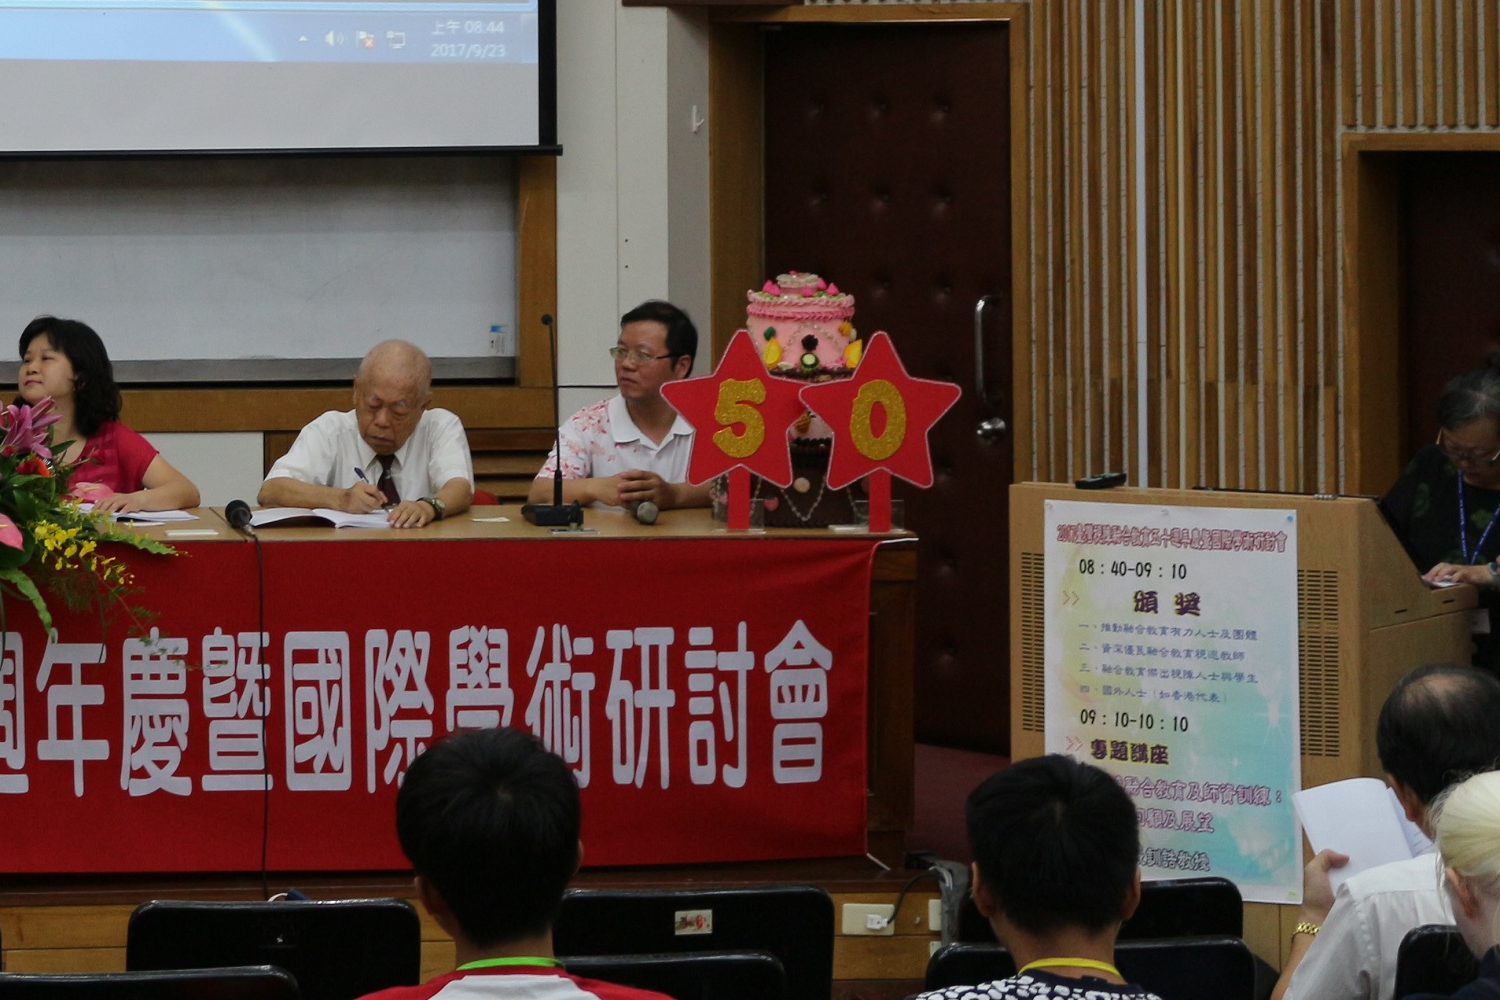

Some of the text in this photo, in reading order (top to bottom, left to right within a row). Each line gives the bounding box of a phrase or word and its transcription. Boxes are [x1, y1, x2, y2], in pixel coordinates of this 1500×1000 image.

[431, 20, 505, 35] 上午 08:44
[431, 43, 505, 58] 2017/9/23
[713, 378, 907, 460] 5 0
[1090, 739, 1170, 766] 專題講座
